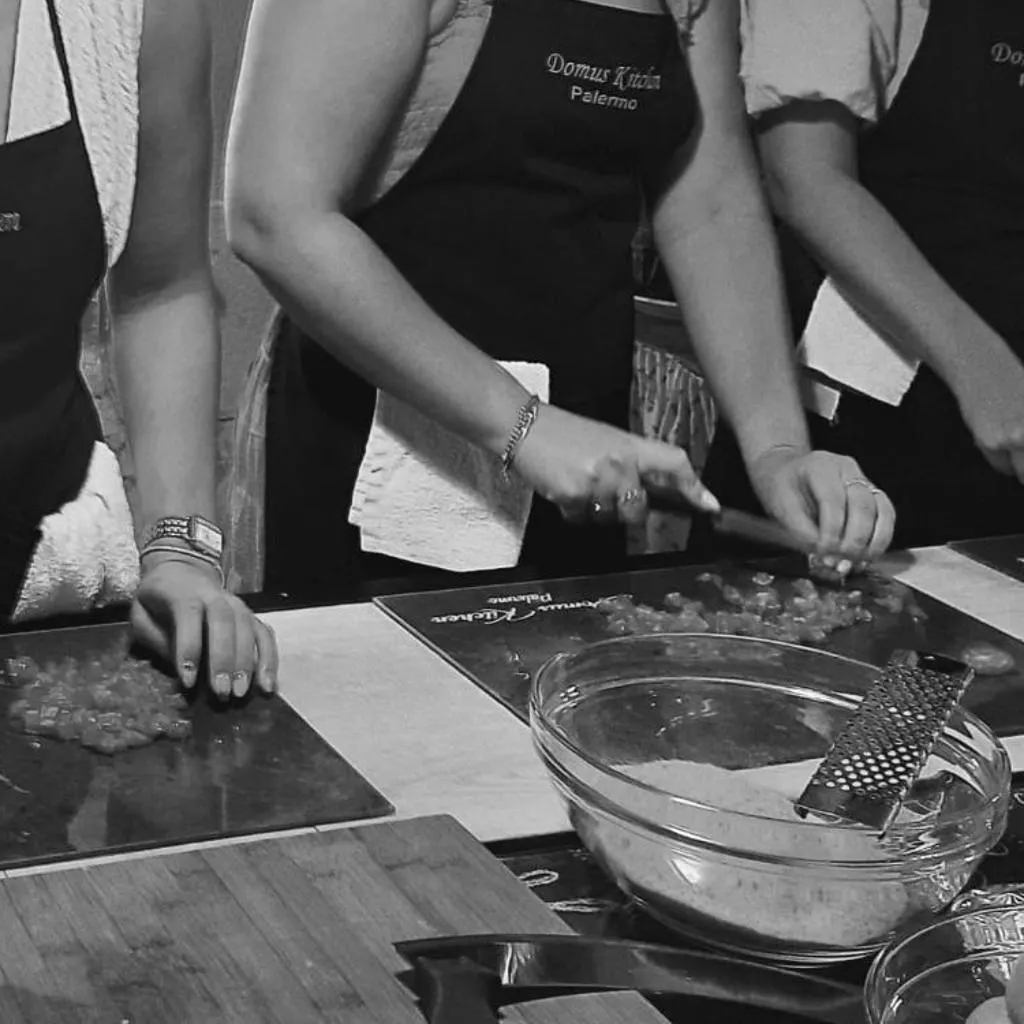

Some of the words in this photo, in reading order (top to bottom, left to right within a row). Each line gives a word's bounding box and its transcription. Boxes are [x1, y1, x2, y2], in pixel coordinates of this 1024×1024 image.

[546, 52, 611, 83] Domus
[570, 85, 638, 110] Palermo
[430, 607, 536, 625] Kitchen
